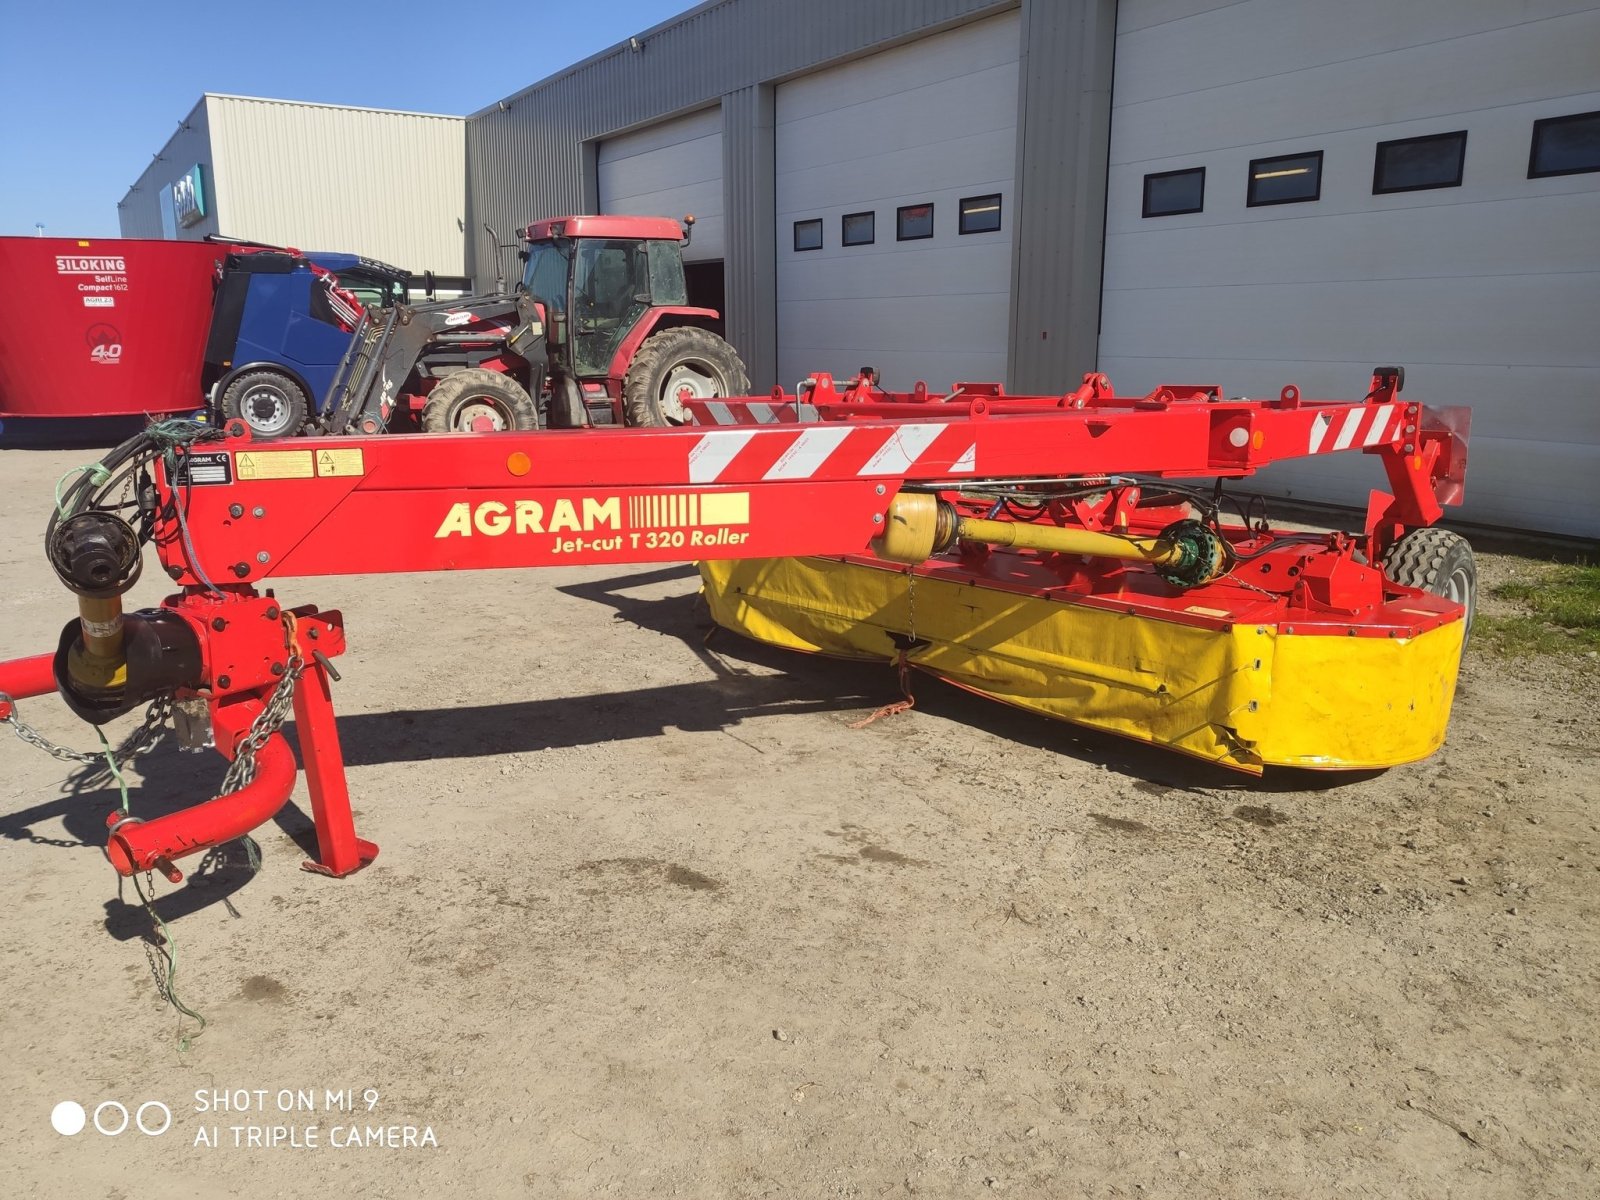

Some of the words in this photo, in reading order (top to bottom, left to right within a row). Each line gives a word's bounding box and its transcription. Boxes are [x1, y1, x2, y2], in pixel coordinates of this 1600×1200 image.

[56, 259, 126, 271] SILOKING
[77, 283, 113, 292] Compact
[434, 497, 621, 539] AGRAM
[551, 536, 623, 554] Jet-cut
[630, 533, 640, 549] T
[645, 531, 684, 549] 320
[690, 528, 749, 547] Roller
